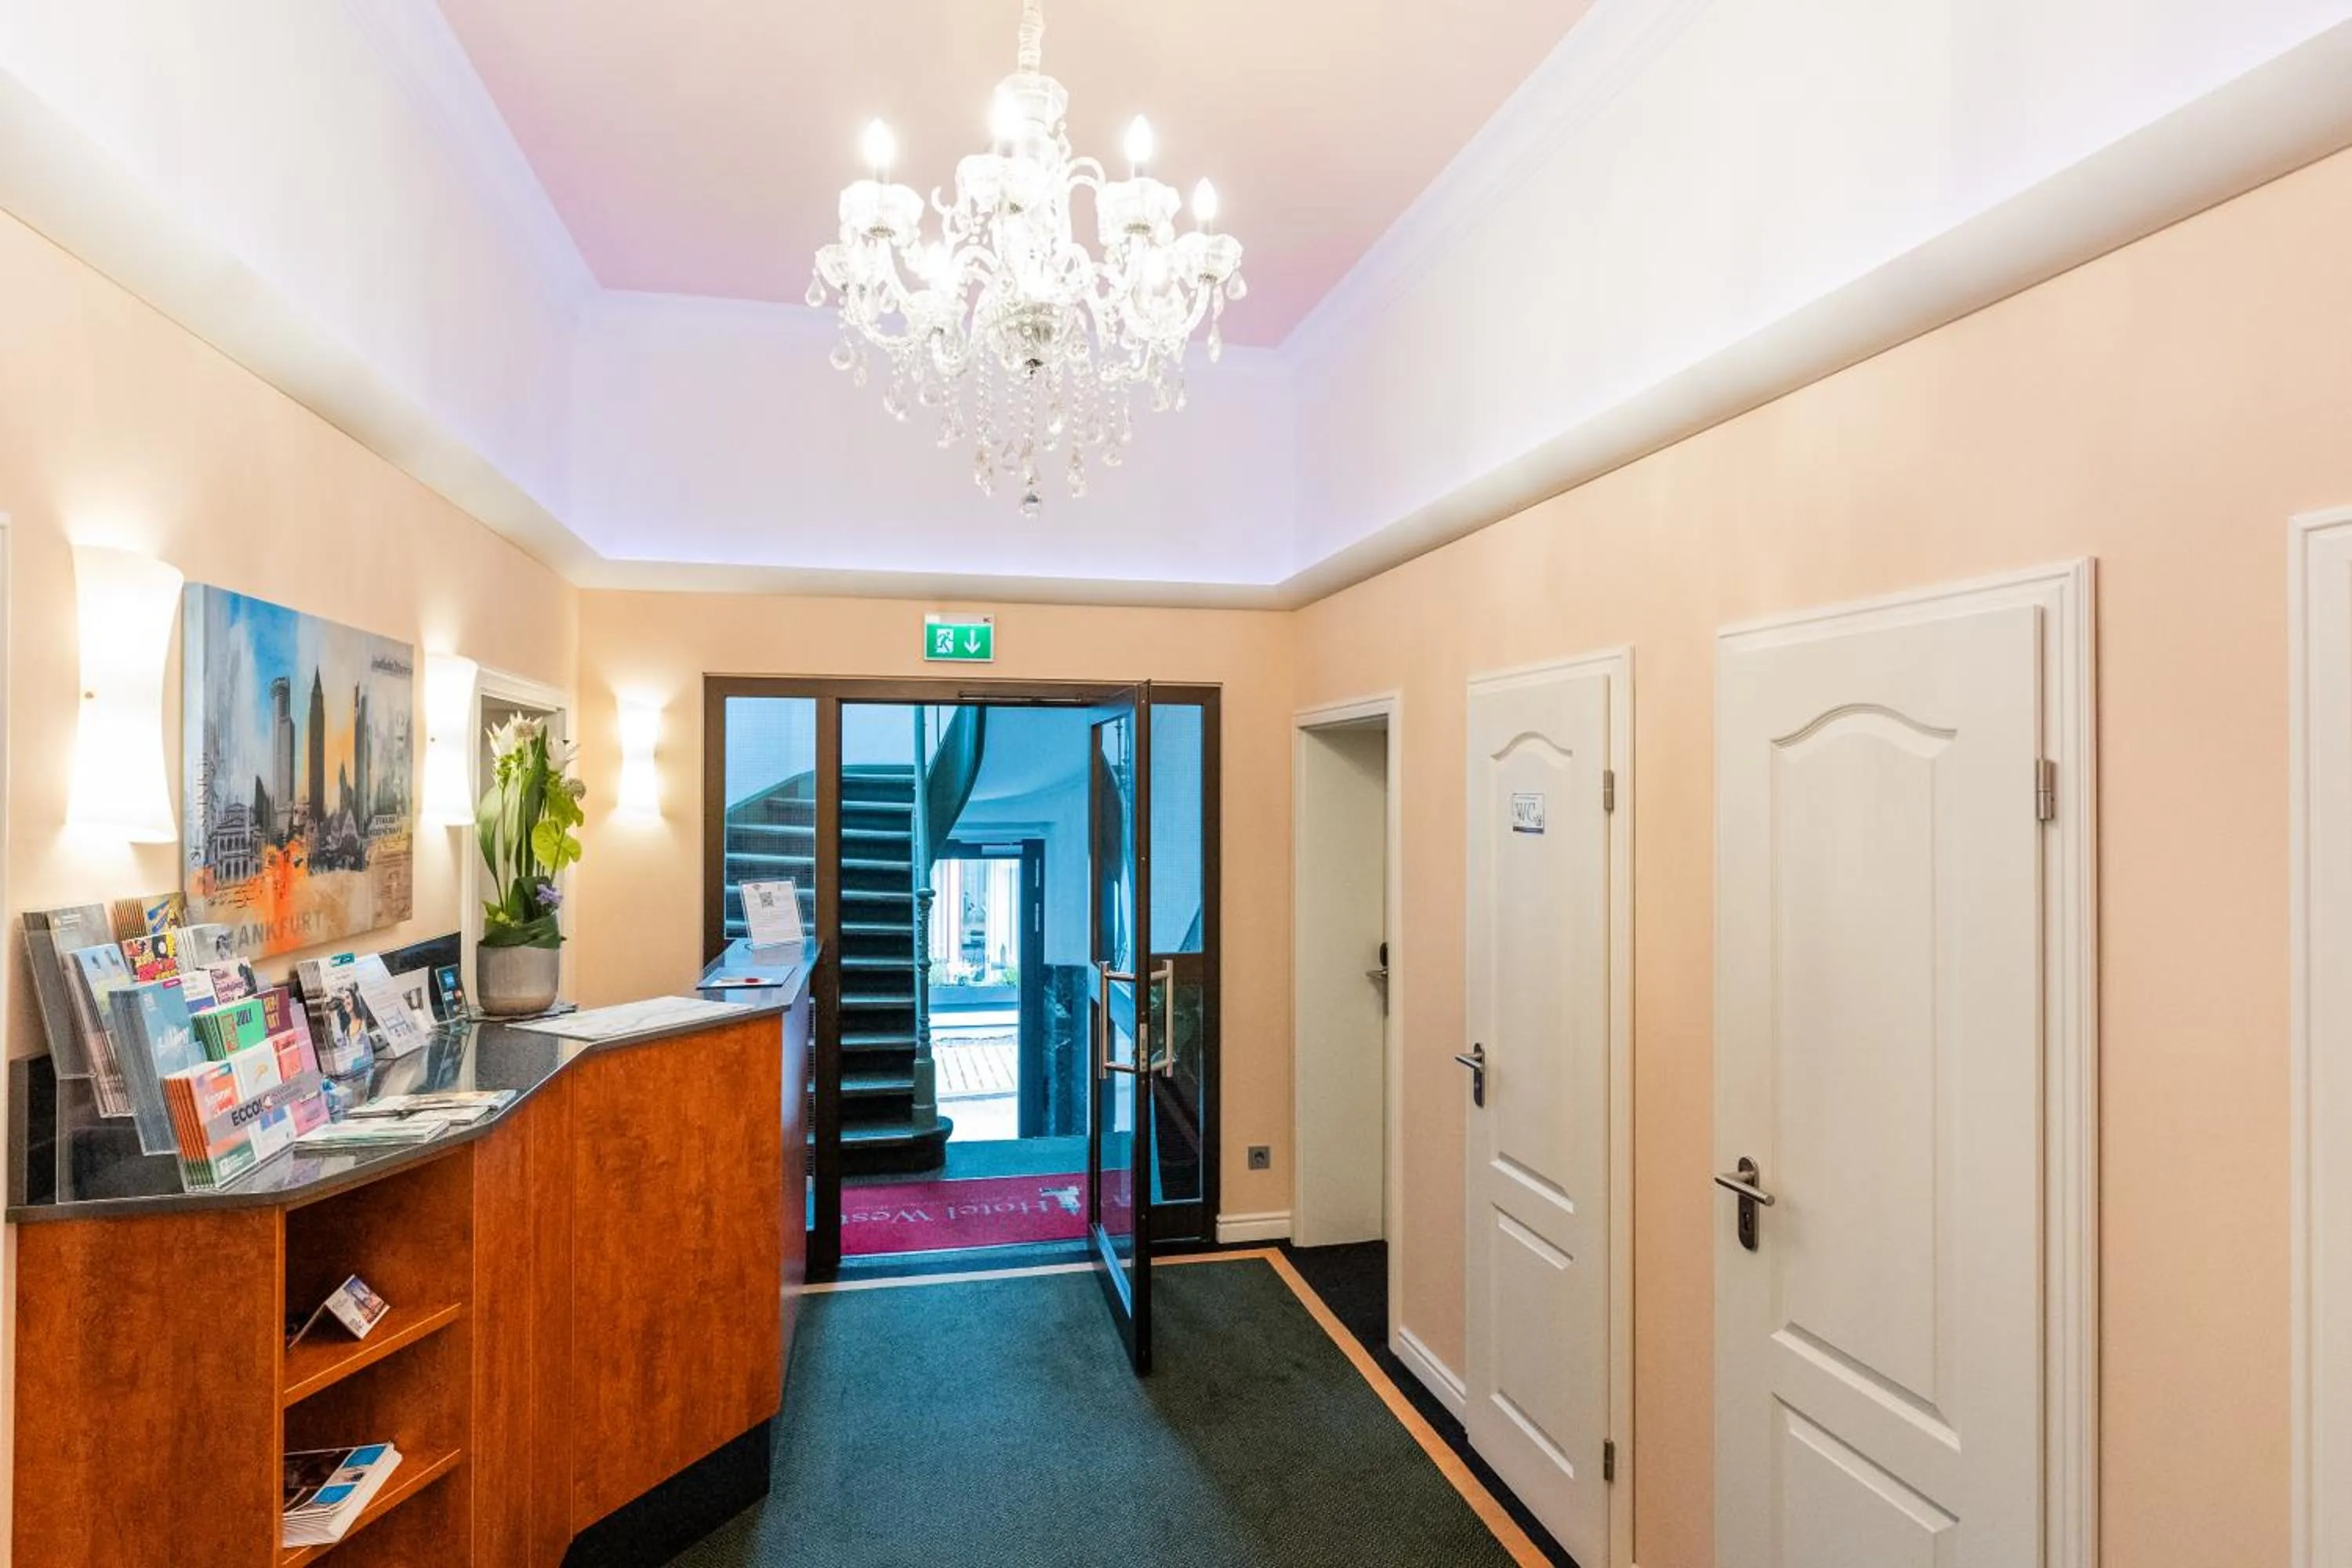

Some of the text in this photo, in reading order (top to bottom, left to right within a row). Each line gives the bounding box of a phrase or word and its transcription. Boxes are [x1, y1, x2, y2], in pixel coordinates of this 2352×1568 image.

[1515, 802, 1536, 822] WC
[238, 912, 321, 949] ANKFURT
[946, 1200, 1049, 1220] Hotel
